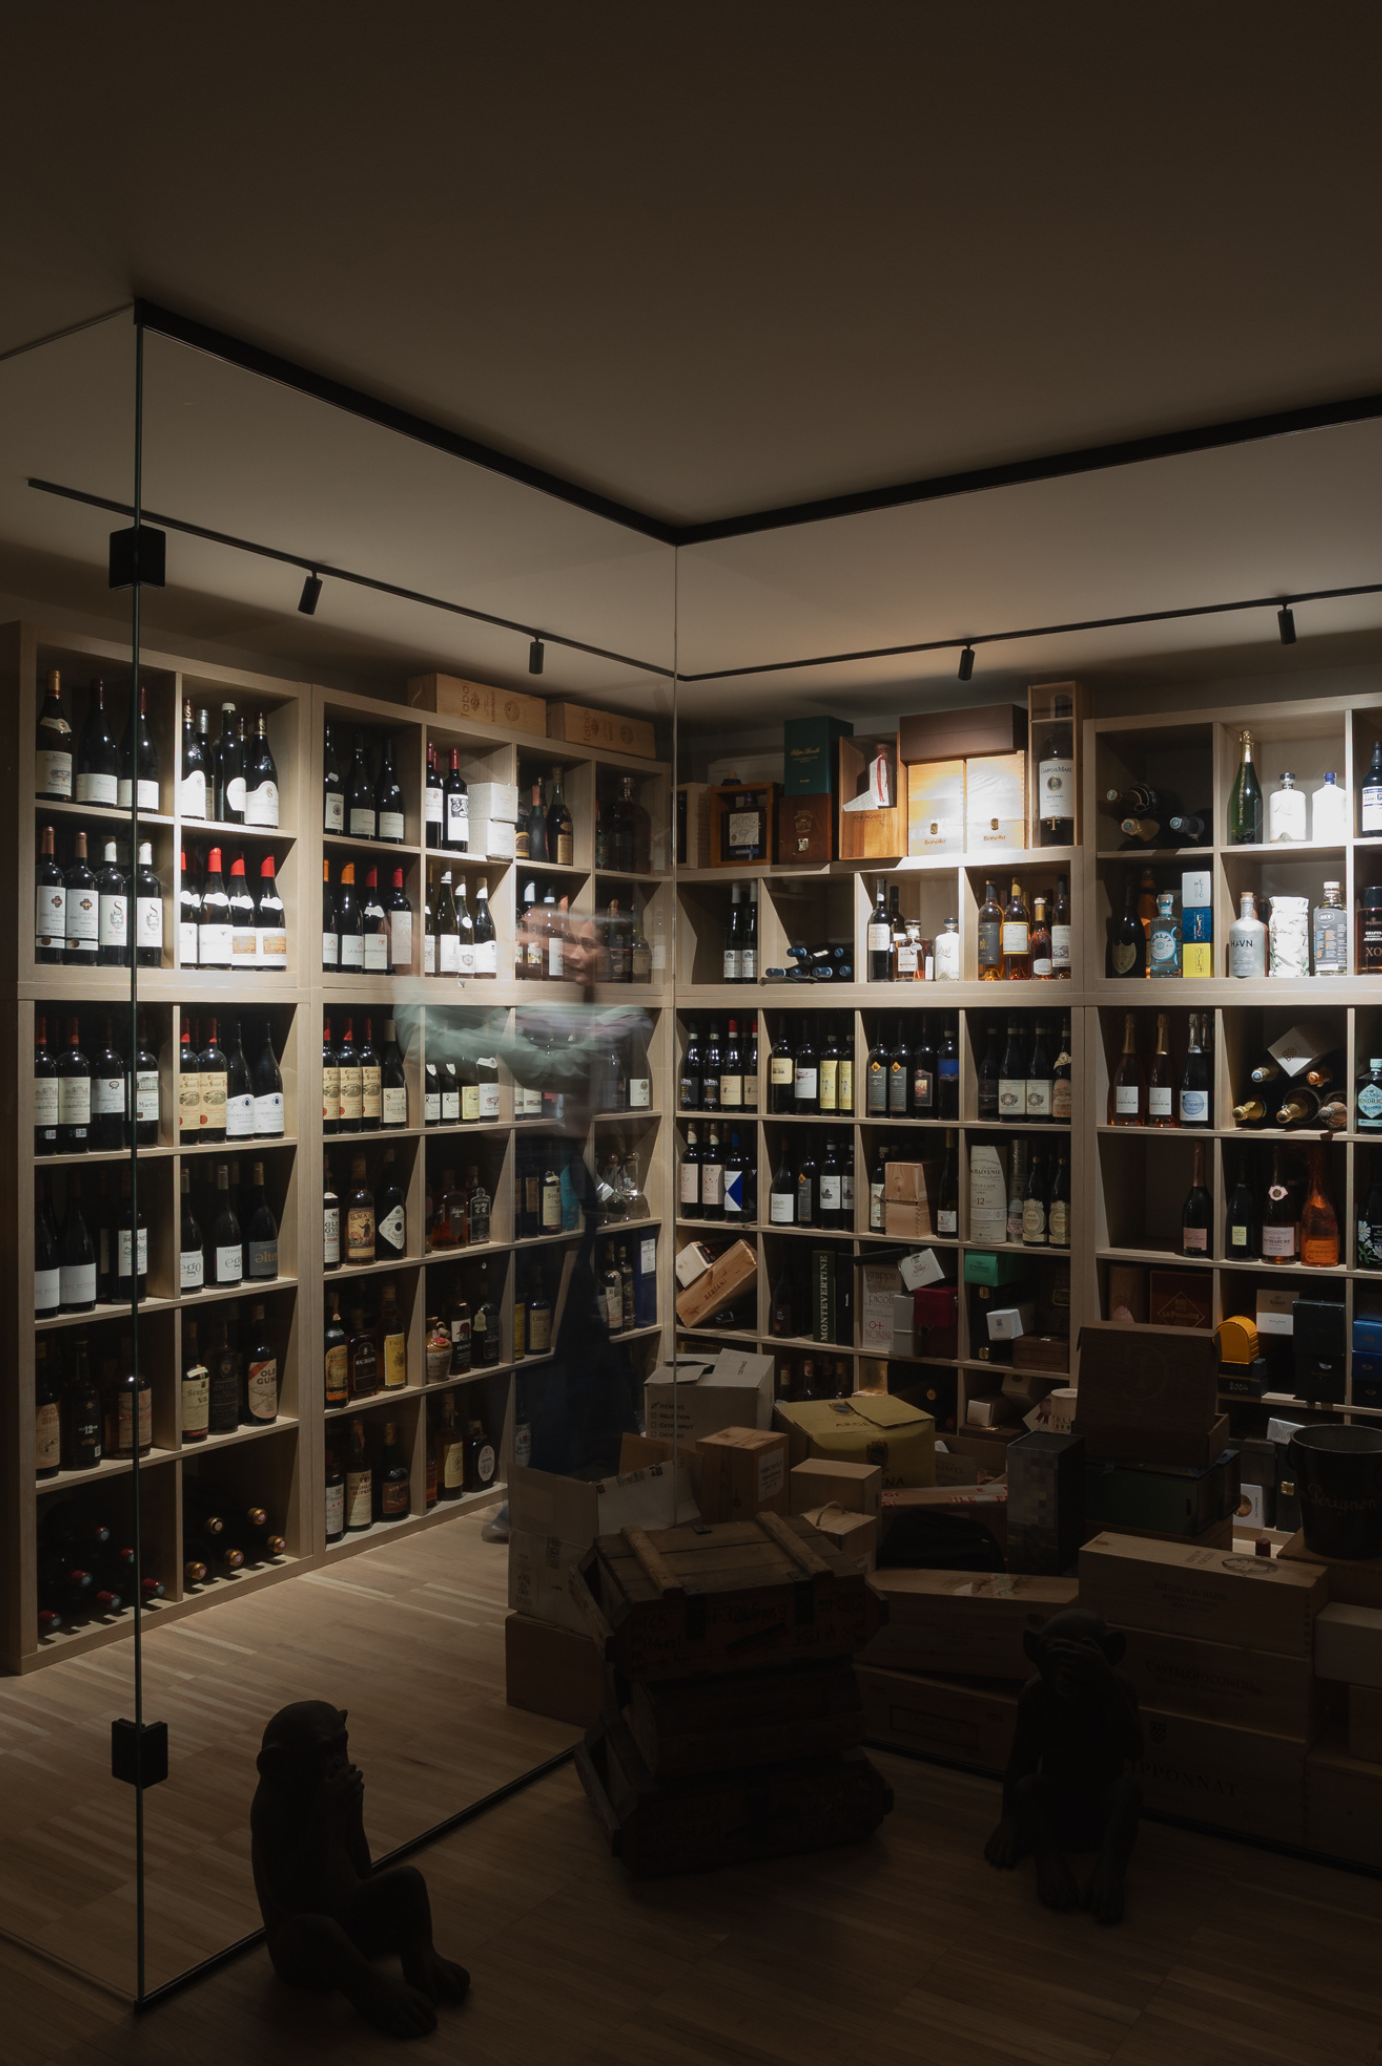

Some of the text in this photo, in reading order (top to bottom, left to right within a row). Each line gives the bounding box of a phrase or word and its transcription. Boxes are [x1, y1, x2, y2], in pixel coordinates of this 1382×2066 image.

[1231, 939, 1253, 948] HAVN
[704, 1278, 727, 1301] BERTANI
[819, 1255, 829, 1342] MONTEVERTINE
[935, 1464, 963, 1475] COSTA
[1131, 1762, 1239, 1797] IPPONNAT
